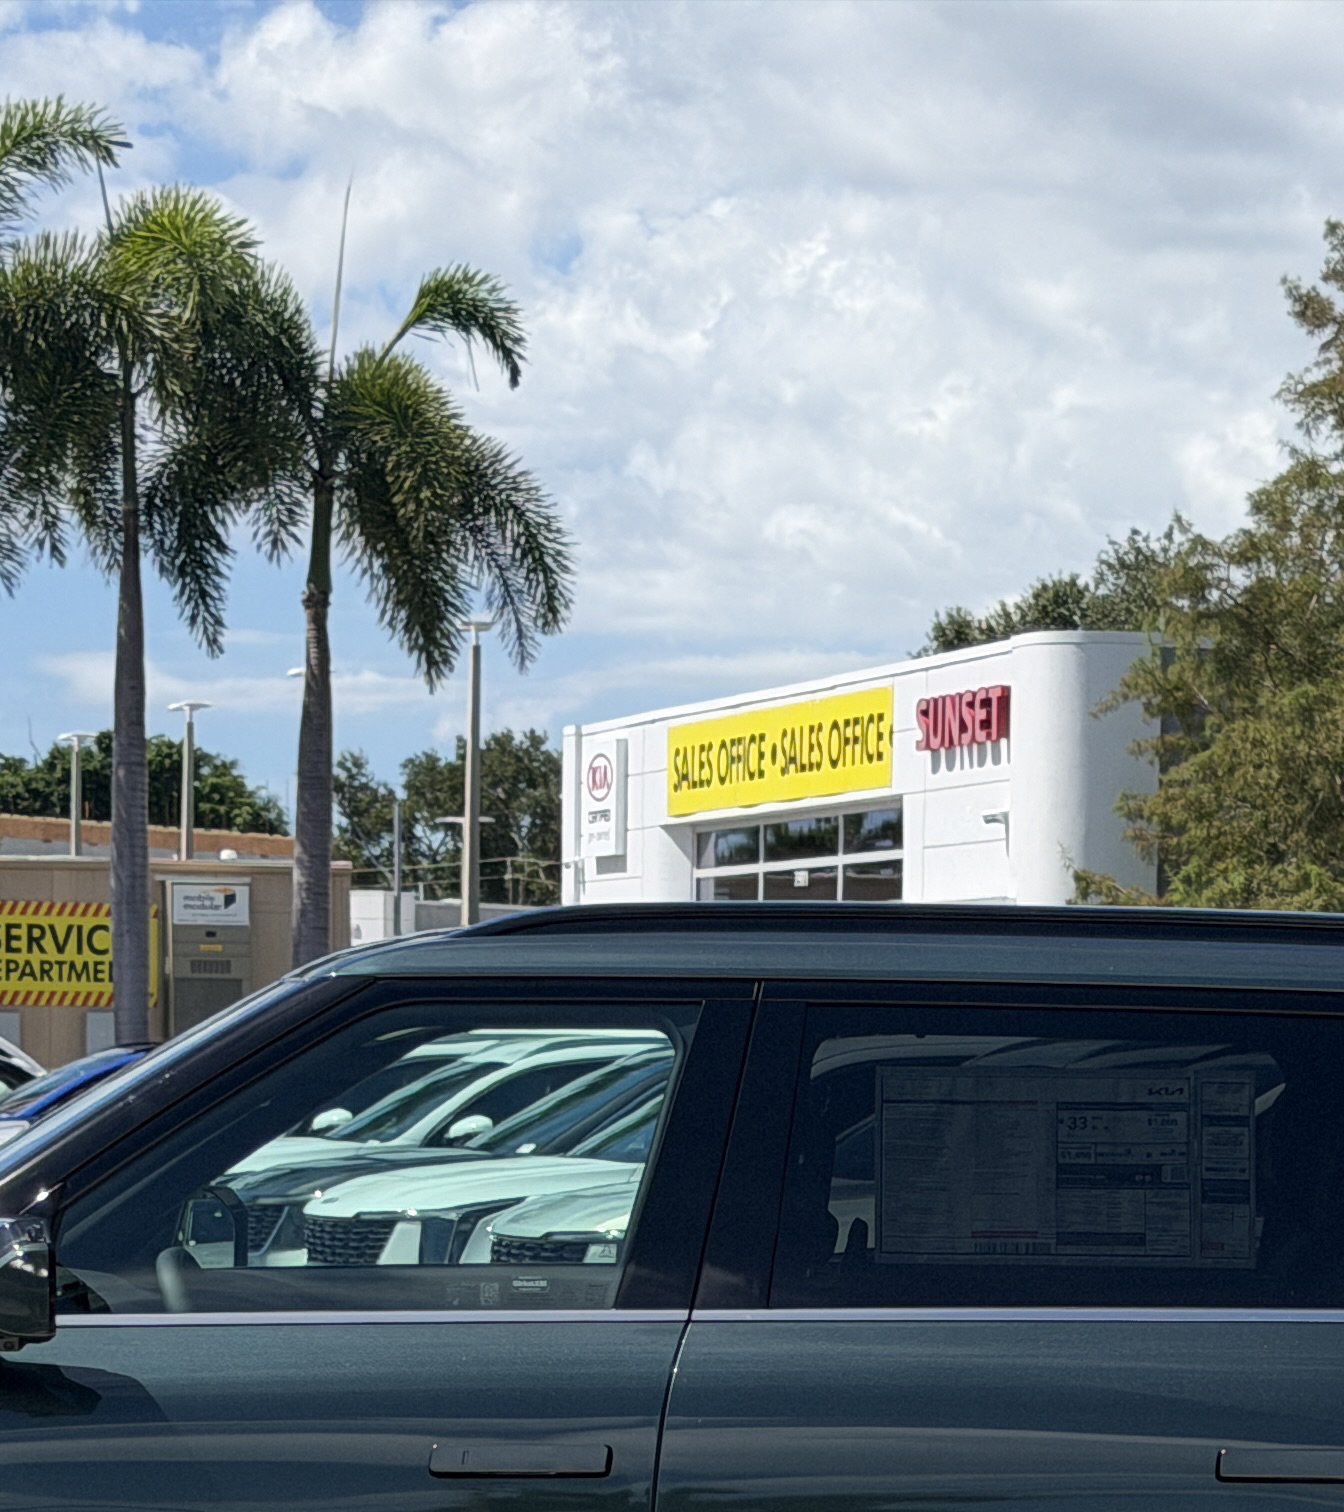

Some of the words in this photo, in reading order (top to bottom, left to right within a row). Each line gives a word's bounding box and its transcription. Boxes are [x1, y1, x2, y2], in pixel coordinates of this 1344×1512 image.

[916, 686, 1006, 751] SUNSET
[673, 741, 713, 793] SALES
[717, 733, 766, 786] OFFICE
[780, 722, 823, 777] SALES
[828, 712, 885, 770] OFFICE
[1067, 1116, 1088, 1131] 33
